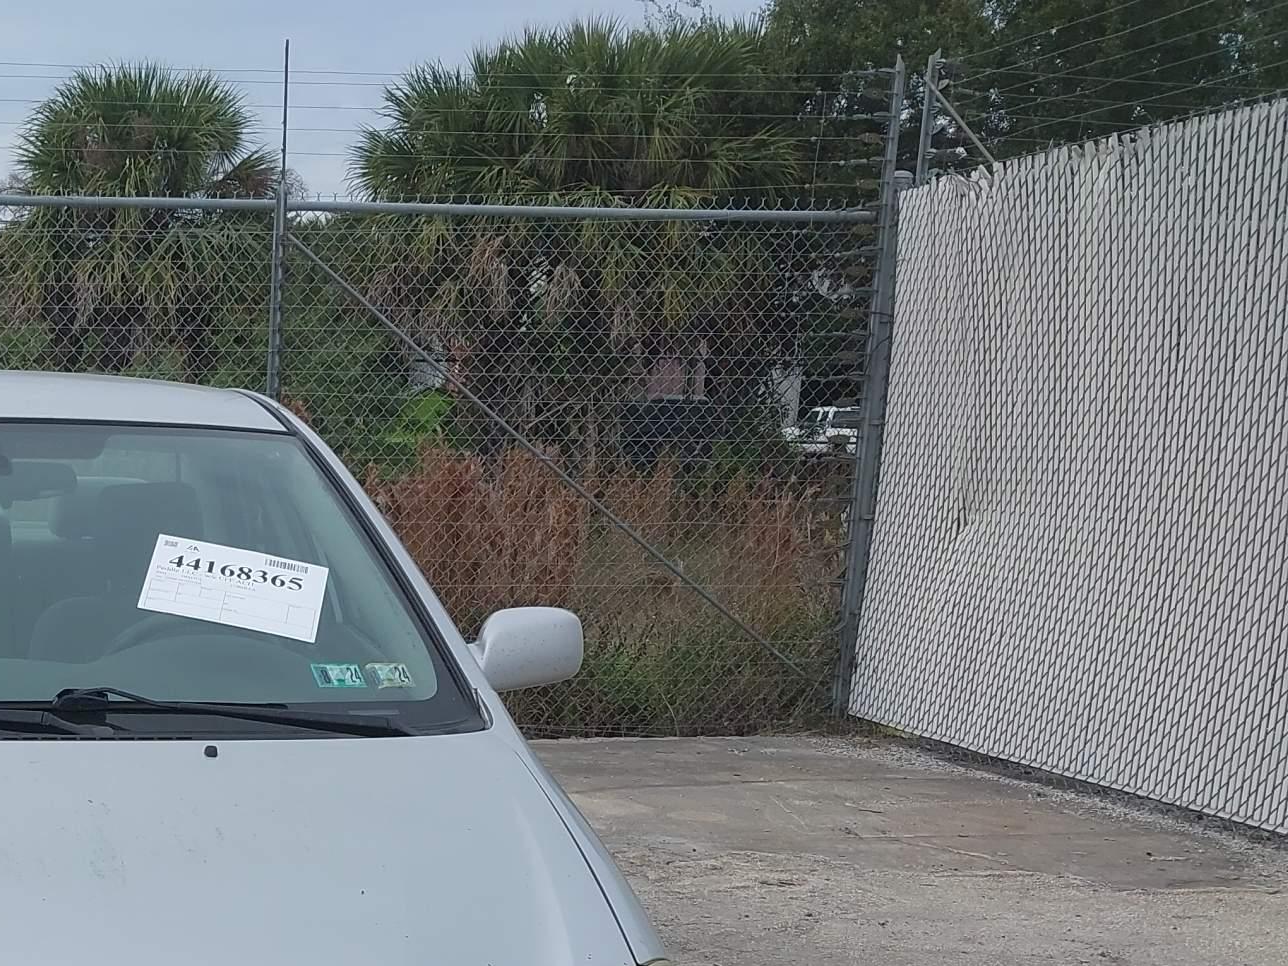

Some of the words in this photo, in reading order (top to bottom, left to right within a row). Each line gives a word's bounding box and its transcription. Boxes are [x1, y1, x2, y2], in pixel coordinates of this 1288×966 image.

[169, 555, 304, 591] 44168365
[346, 667, 362, 683] 24
[393, 667, 410, 683] 24
